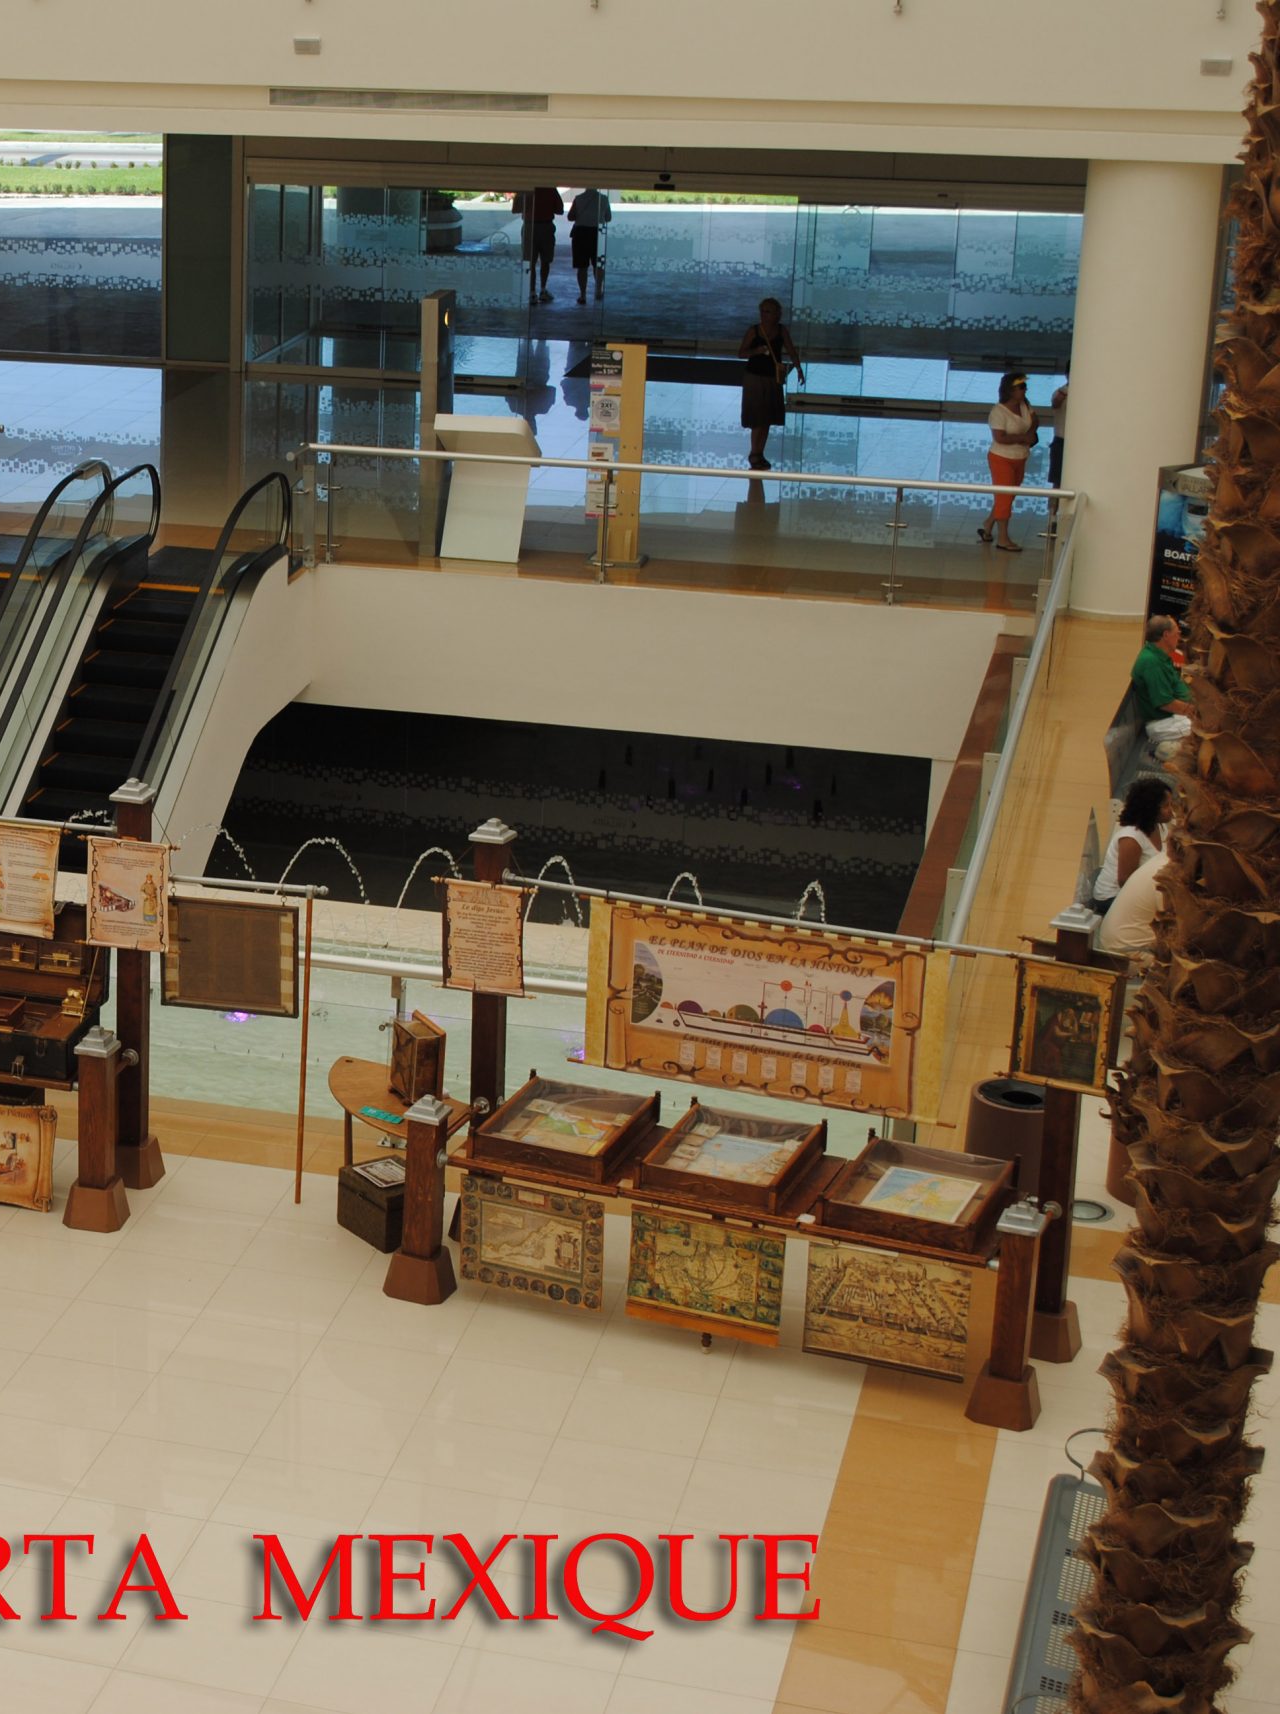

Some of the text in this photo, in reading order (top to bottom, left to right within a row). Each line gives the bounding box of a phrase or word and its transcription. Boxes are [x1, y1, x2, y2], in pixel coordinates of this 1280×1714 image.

[649, 935, 876, 978] EL PLAN DE DIOS EN LA HISTORIA
[682, 1033, 700, 1042] Las
[701, 1036, 722, 1047] siete
